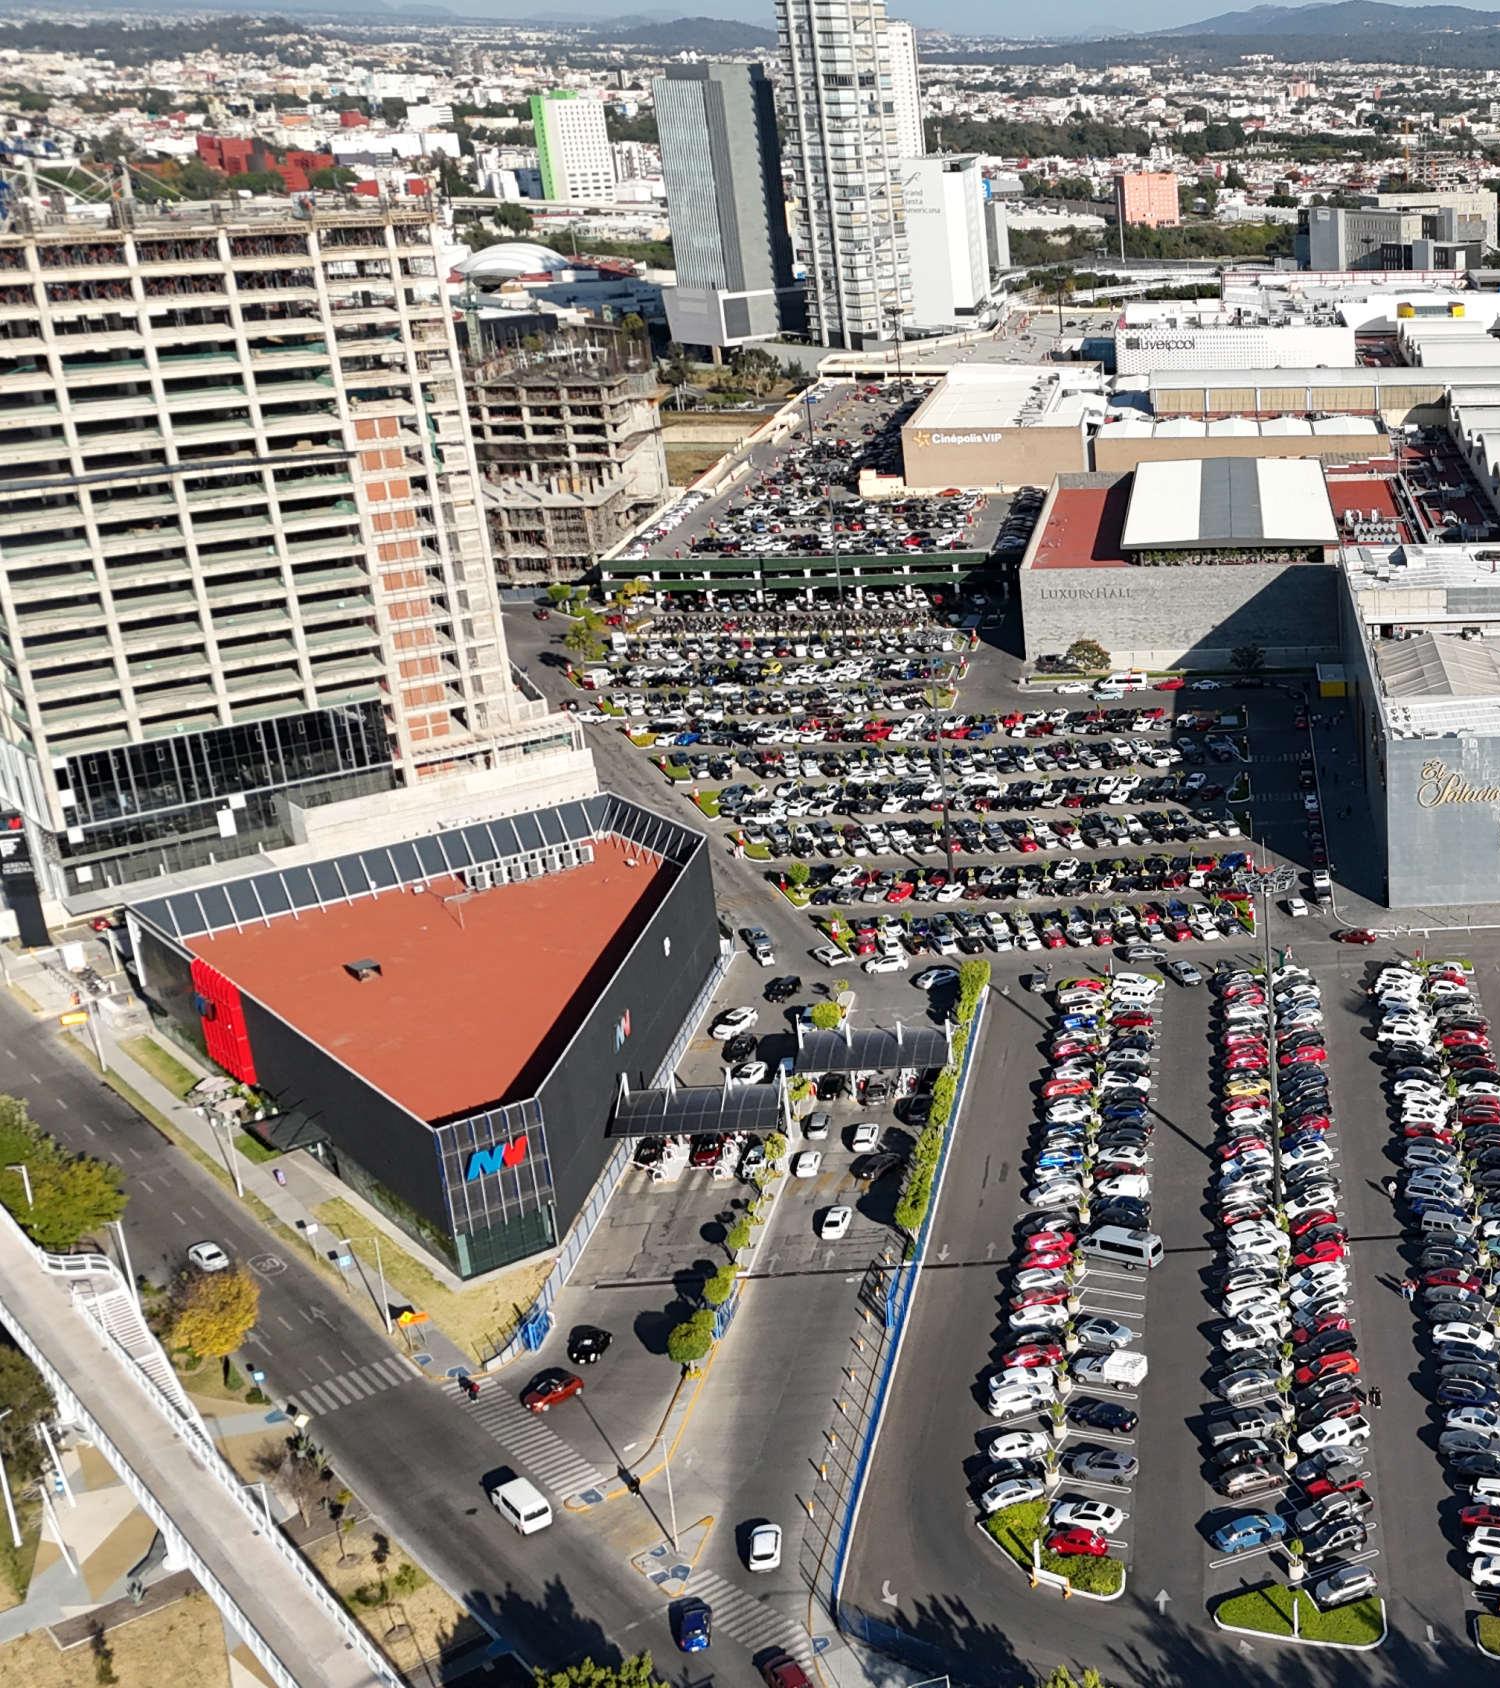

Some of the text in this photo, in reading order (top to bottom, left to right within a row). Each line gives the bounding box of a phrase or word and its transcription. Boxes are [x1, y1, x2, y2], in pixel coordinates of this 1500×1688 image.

[1141, 336, 1195, 350] Liverpool
[931, 433, 1002, 445] Cinépolis VIP
